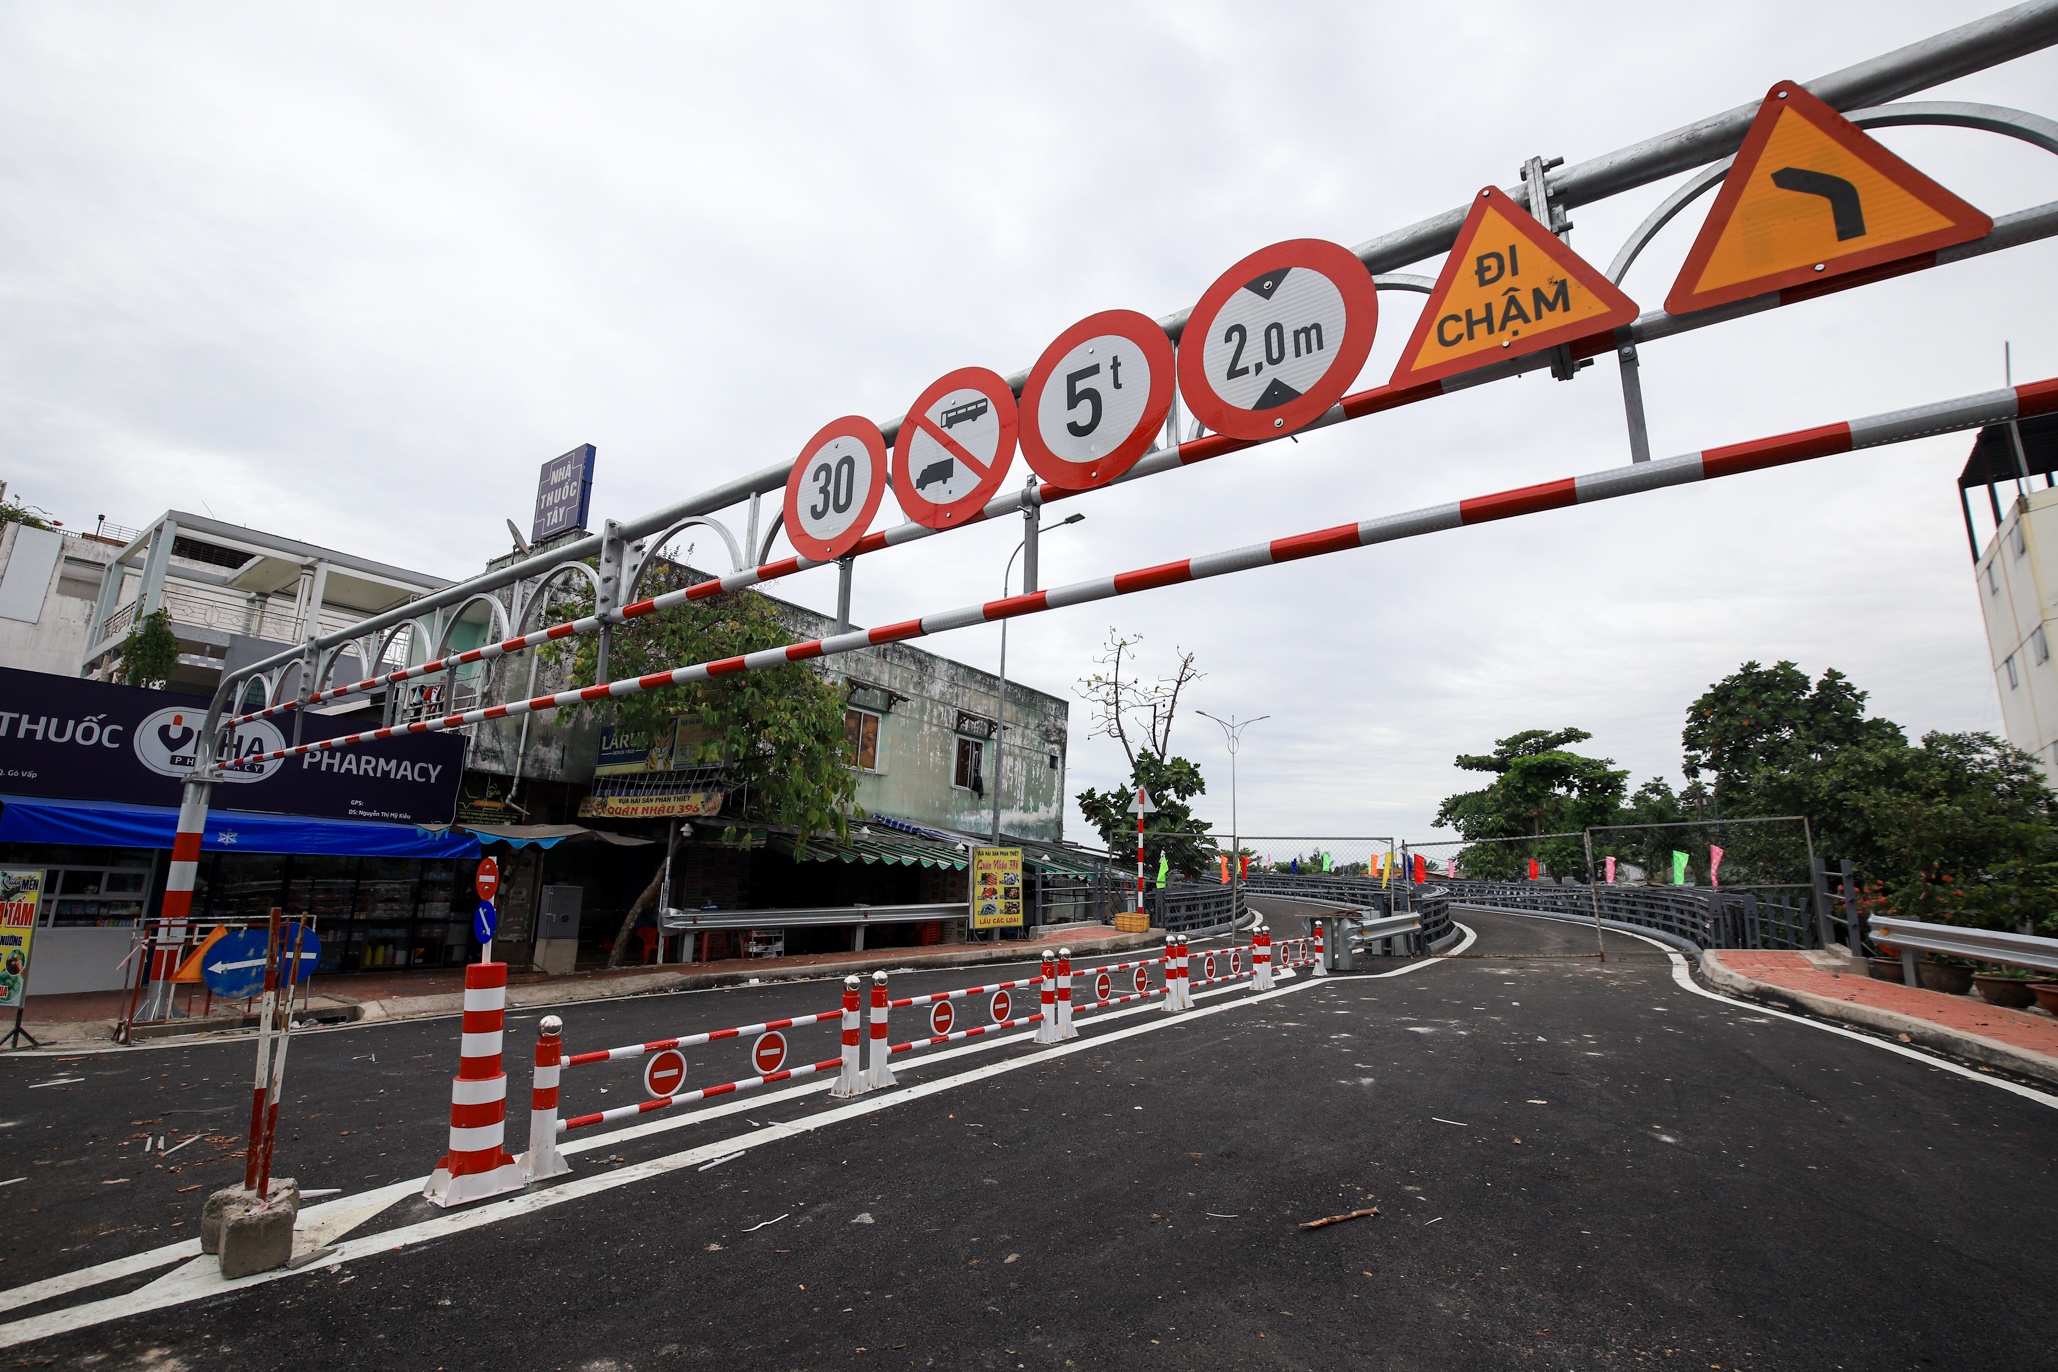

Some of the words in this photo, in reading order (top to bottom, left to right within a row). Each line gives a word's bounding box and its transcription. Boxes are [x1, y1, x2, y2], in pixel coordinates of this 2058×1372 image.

[1474, 243, 1520, 289] ĐI
[1436, 278, 1572, 348] CHẬM
[550, 460, 573, 486] NHÀ
[810, 454, 856, 521] 30
[540, 478, 578, 510] THUỐC
[546, 506, 566, 527] TÂY
[0, 711, 124, 749] THUỐC
[7, 769, 19, 777] Gò
[302, 750, 443, 784] PHARMACY
[607, 804, 639, 816] QUÁN
[677, 803, 700, 814] 396
[21, 875, 40, 891] MẾN
[6, 895, 36, 927] TẤM
